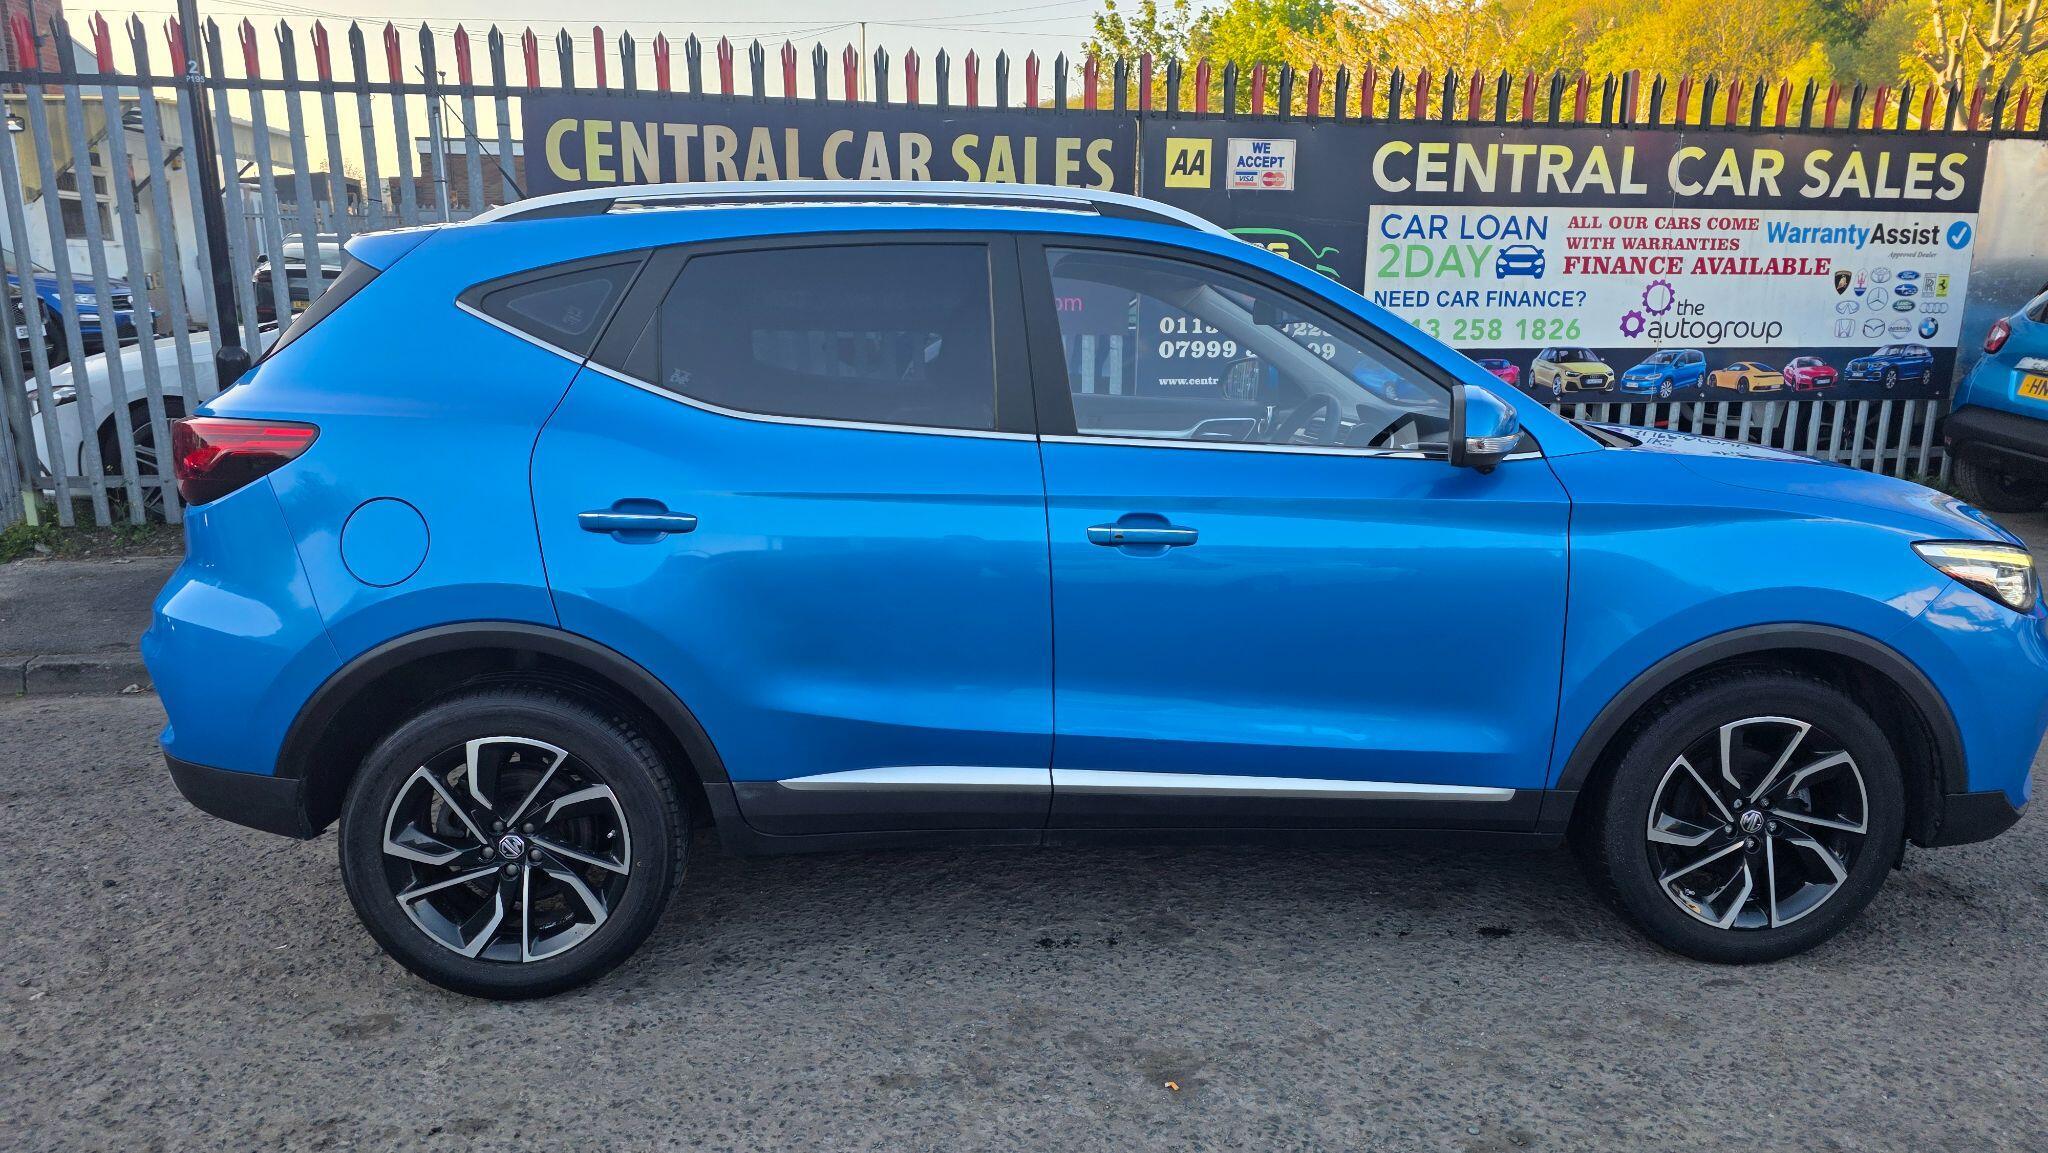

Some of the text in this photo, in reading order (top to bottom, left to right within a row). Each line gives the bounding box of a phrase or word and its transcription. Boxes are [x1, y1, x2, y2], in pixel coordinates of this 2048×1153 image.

[188, 60, 199, 74] 2
[545, 118, 1115, 192] CENTRAL CAR SALES
[1252, 142, 1271, 154] WE
[1170, 149, 1206, 176] AA
[1236, 156, 1285, 168] ACCEPT
[1372, 140, 1968, 201] CENTRAL CAR SALES
[1381, 213, 1549, 241] CAR LOAN
[1568, 216, 1760, 231] ALL OUR CARS COME
[1566, 237, 1741, 251] WITH WARRANTIES
[1377, 244, 1494, 278] 2DAY
[1888, 251, 1916, 260] Approved
[1562, 256, 1832, 276] FINANCE AVAILABLE
[1374, 290, 1588, 308] NEED CAR FINANCE?
[1676, 298, 1705, 316] the
[1452, 318, 1503, 341] 258
[1515, 318, 1581, 341] 1826
[1647, 317, 1782, 345] autogroup
[1158, 340, 1237, 358] 07999
